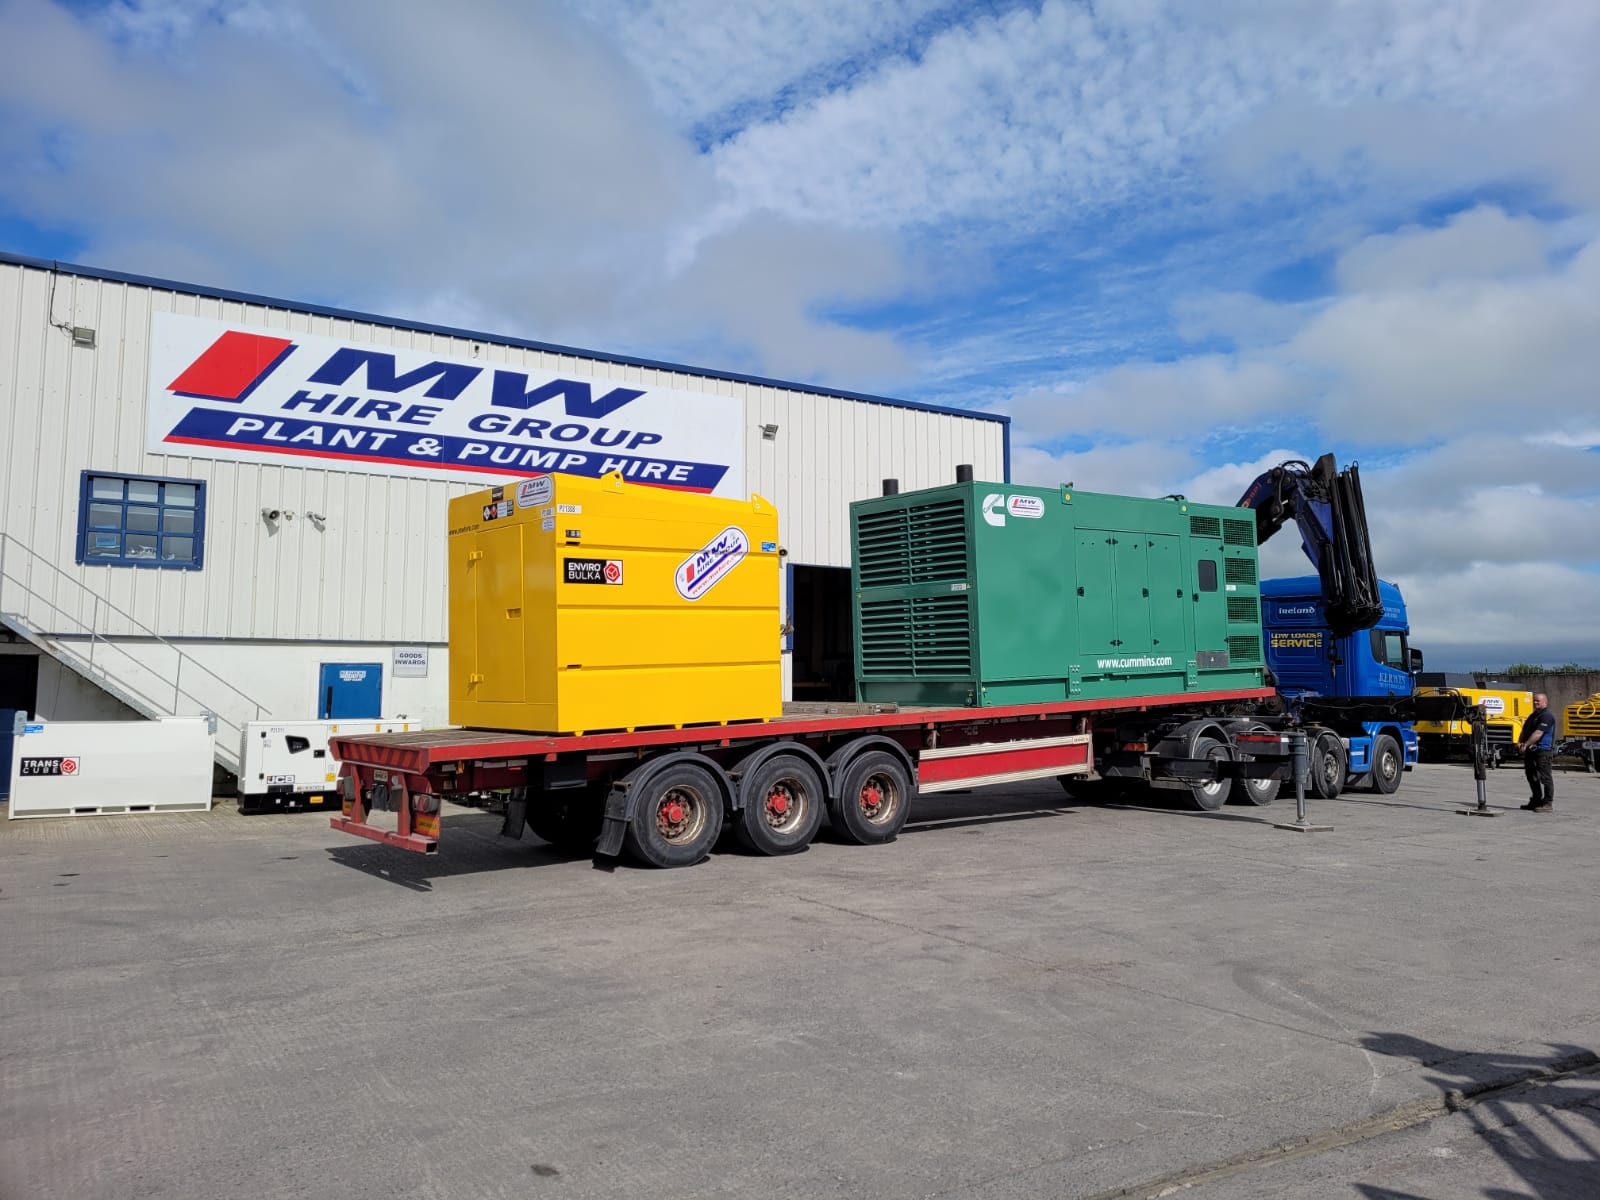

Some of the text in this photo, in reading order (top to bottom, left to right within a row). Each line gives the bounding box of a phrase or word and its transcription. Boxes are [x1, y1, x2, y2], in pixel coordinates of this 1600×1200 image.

[306, 347, 647, 419] MW
[280, 390, 662, 450] HIRE GROUP
[226, 417, 695, 482] PLANT & PUMP HIRE
[527, 480, 546, 489] MW
[696, 535, 728, 567] MW
[568, 562, 601, 571] ENVIRO
[696, 558, 715, 575] HIRE
[568, 571, 601, 580] BULKA
[1291, 631, 1323, 639] LOADER
[1271, 639, 1323, 648] SERVICE
[1097, 655, 1173, 669] www.cummins.com
[23, 760, 60, 768] TRANS
[267, 775, 296, 785] JCB
